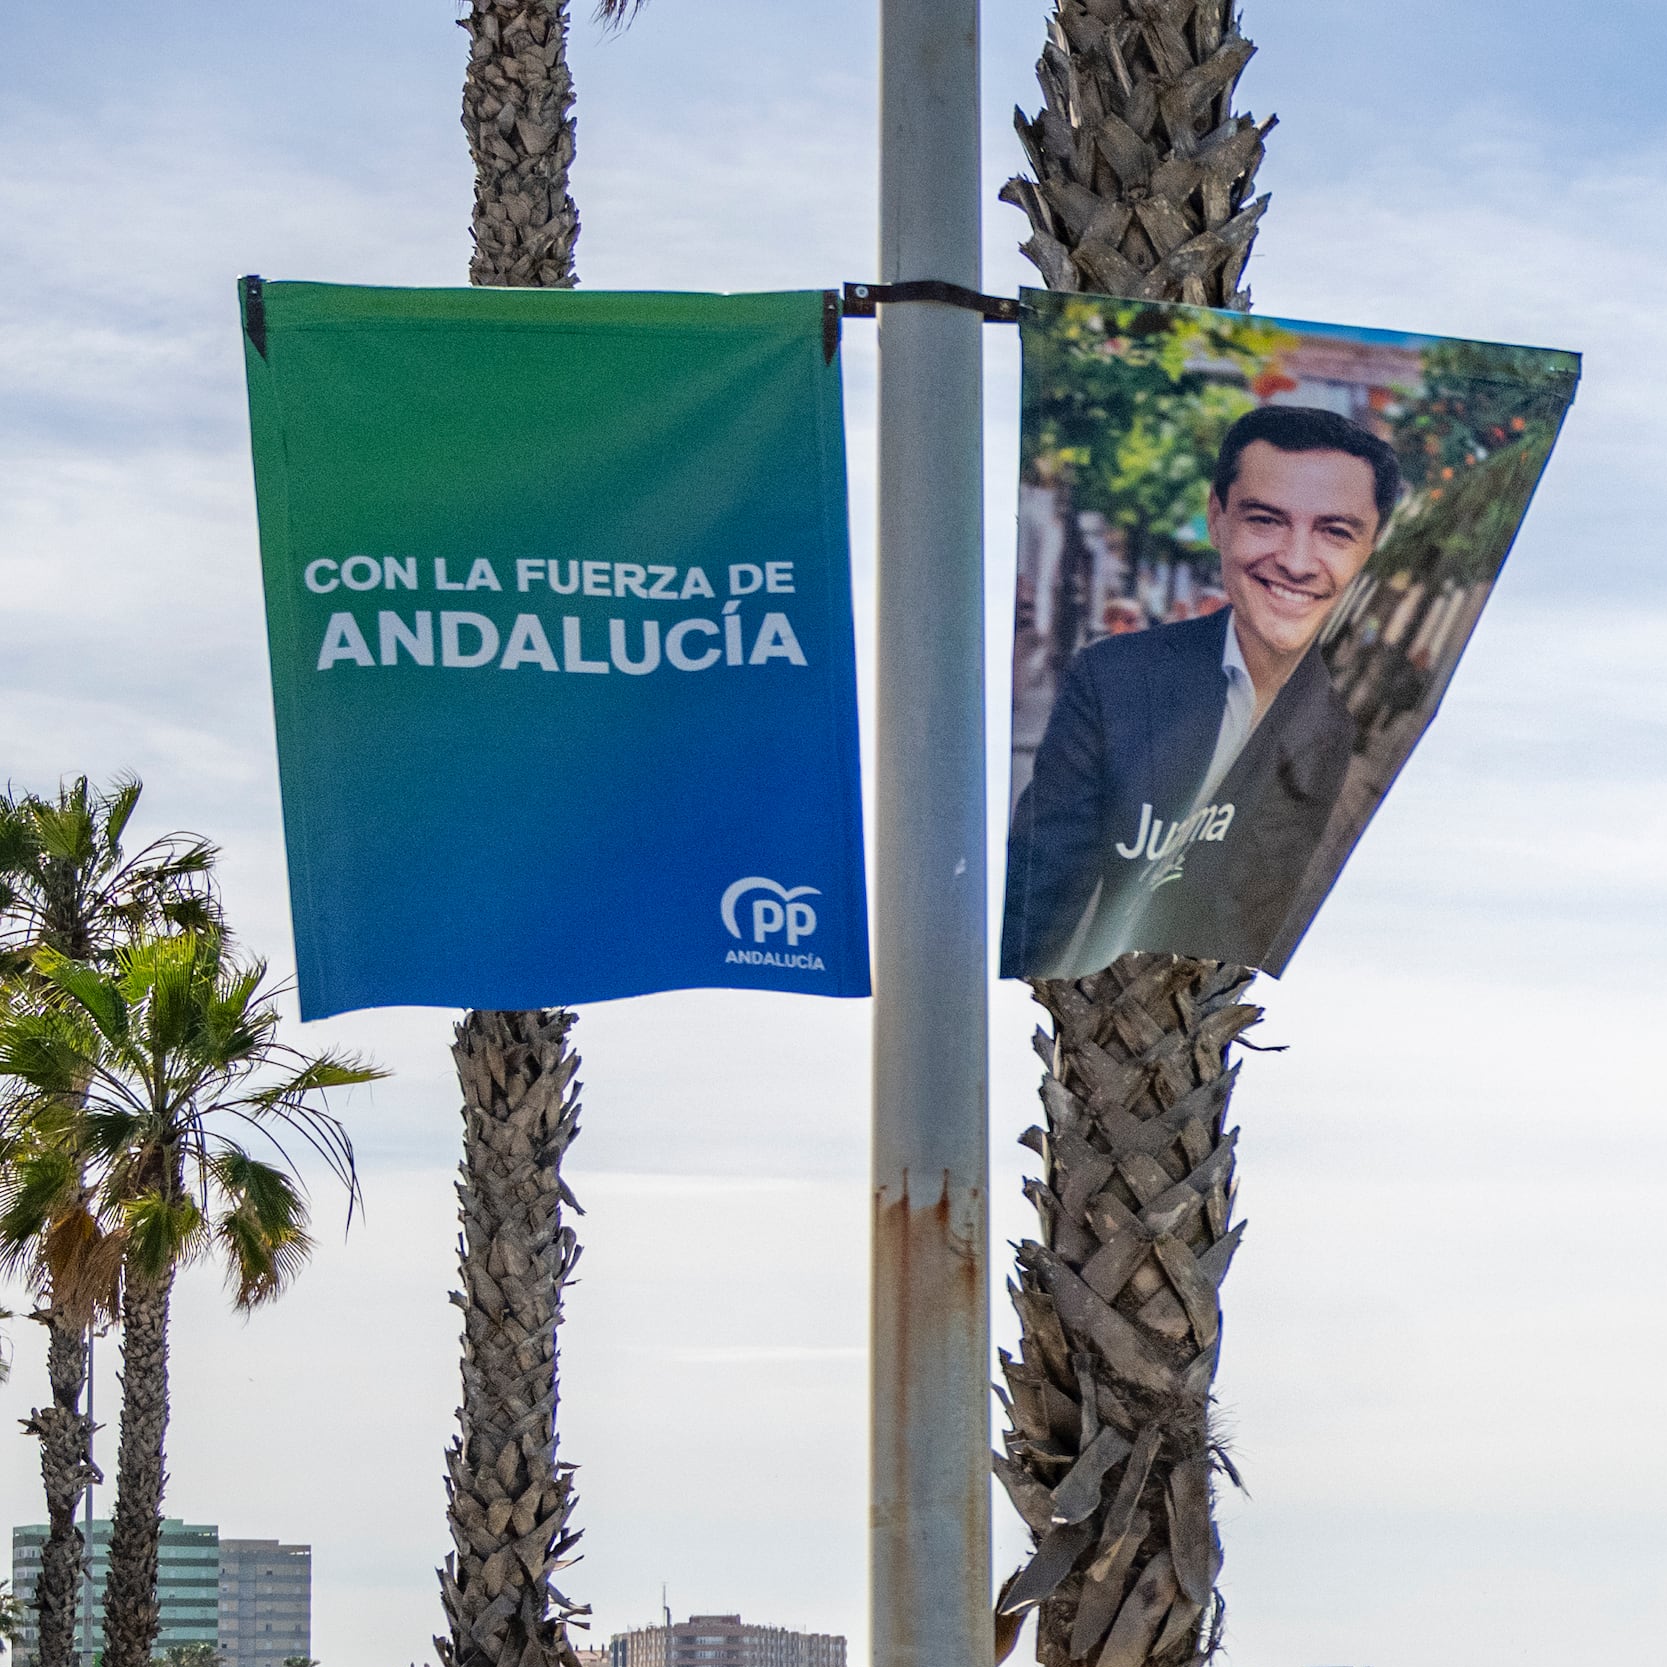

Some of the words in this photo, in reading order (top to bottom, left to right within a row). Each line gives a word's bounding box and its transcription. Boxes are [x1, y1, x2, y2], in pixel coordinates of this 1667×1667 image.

[303, 555, 418, 595] CON
[434, 557, 502, 592] LA
[516, 558, 715, 600] FUERZA
[728, 561, 795, 596] DE
[316, 600, 808, 676] ANDALUCÍA
[725, 950, 826, 972] ANDALUCÍA
